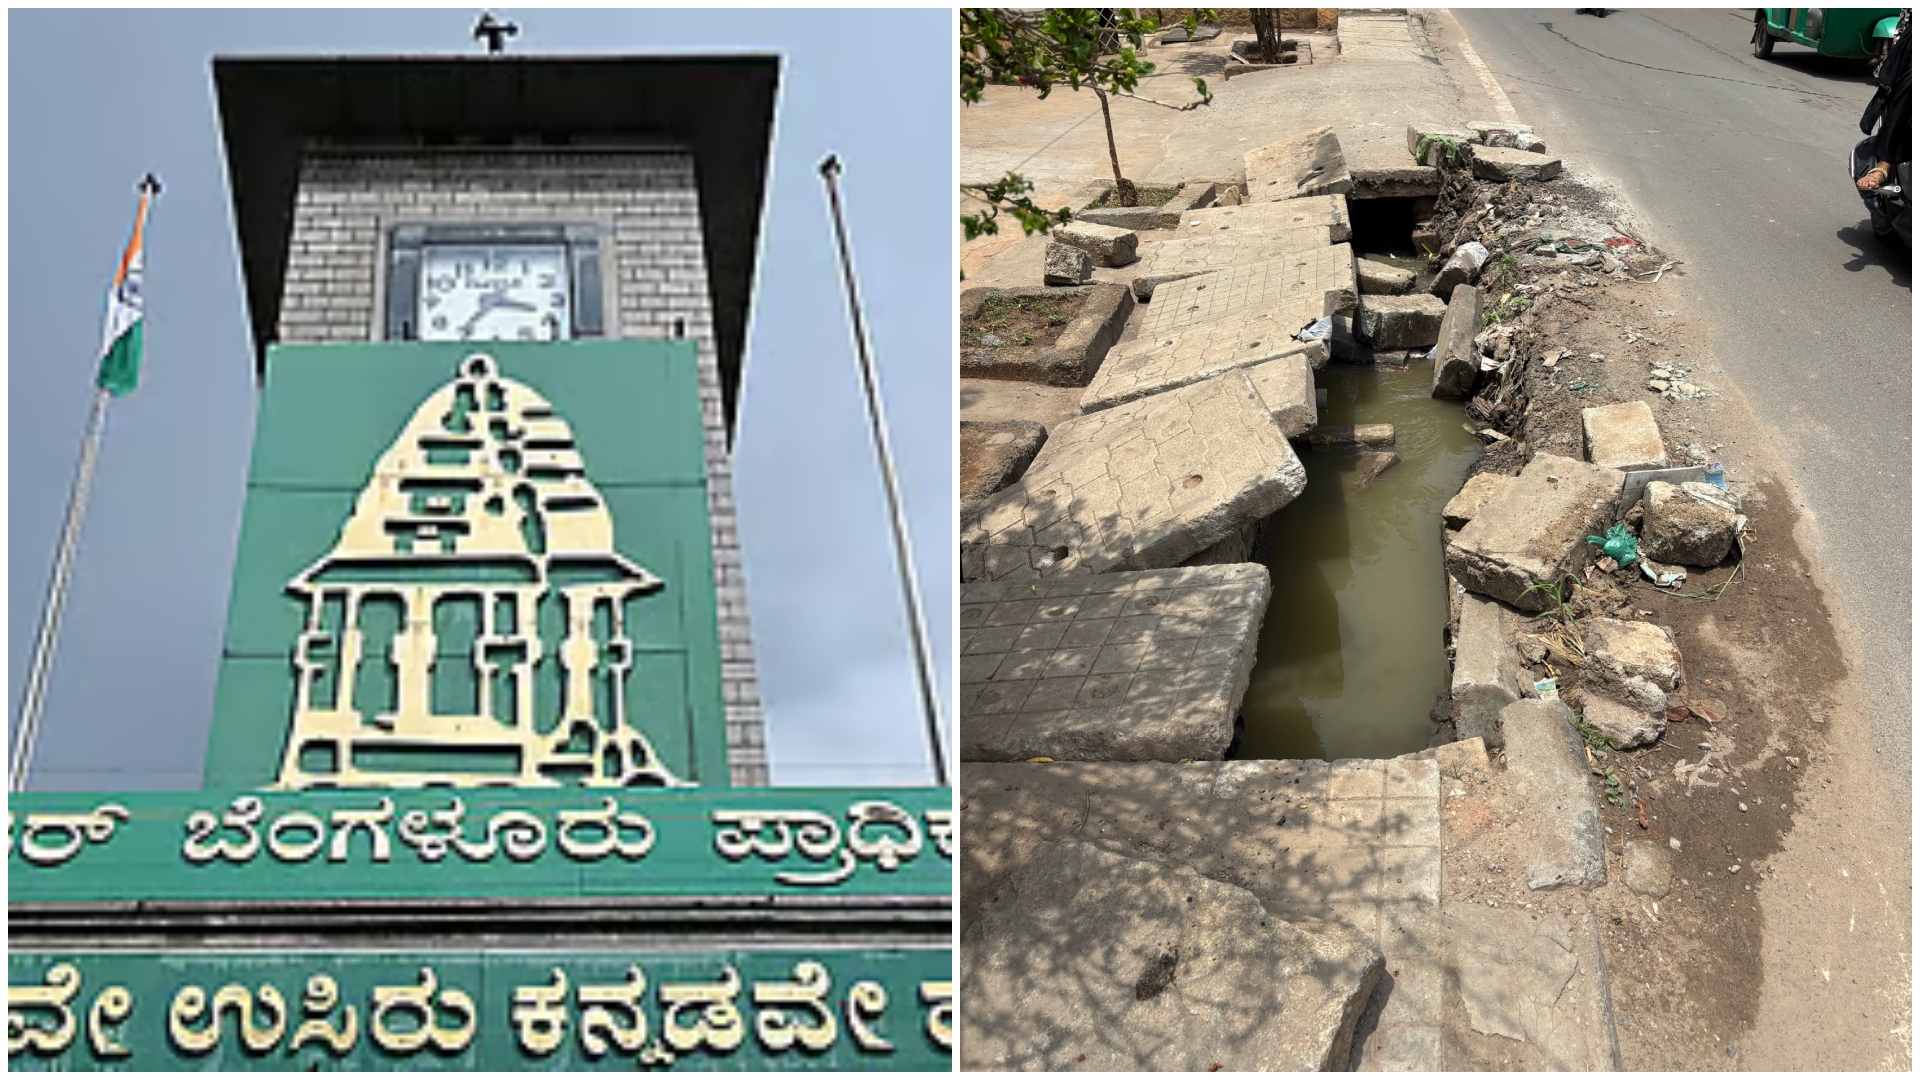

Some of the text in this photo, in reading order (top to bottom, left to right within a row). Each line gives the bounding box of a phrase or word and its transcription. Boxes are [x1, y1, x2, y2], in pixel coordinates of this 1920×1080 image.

[183, 795, 655, 864] ಬೆಂಗಳೂರು
[167, 966, 476, 1056] ಉಸಿರು
[511, 960, 894, 1066] ಕನ್ನಡವೇ
